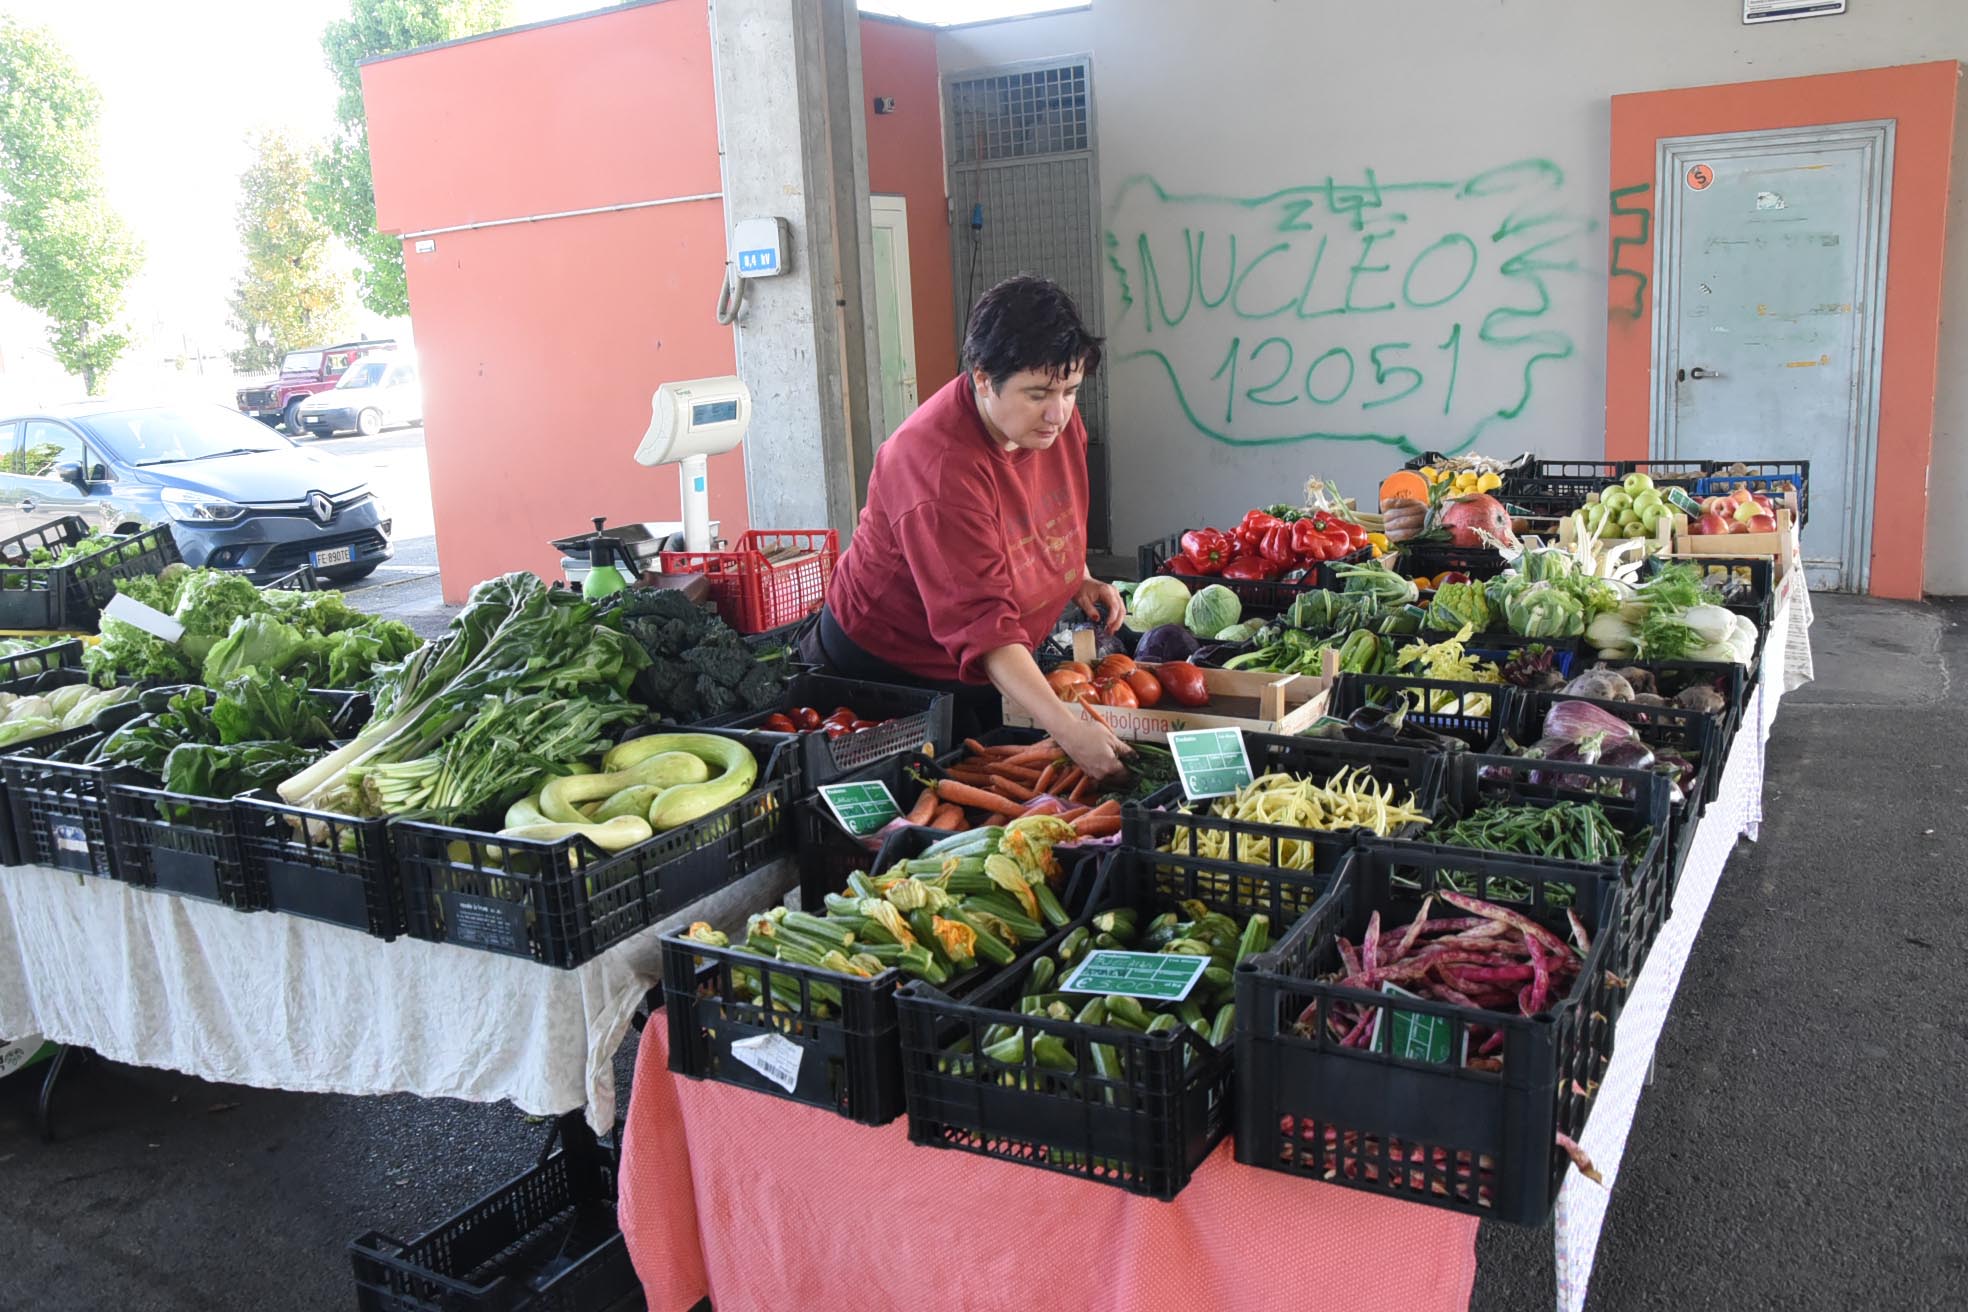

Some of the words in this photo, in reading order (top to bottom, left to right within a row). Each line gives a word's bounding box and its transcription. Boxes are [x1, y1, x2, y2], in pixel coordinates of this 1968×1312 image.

[1137, 228, 1478, 333] NUCLEO
[1211, 323, 1460, 424] 12051
[1080, 709, 1169, 735] Aibologna
[1076, 977, 1093, 988] €
